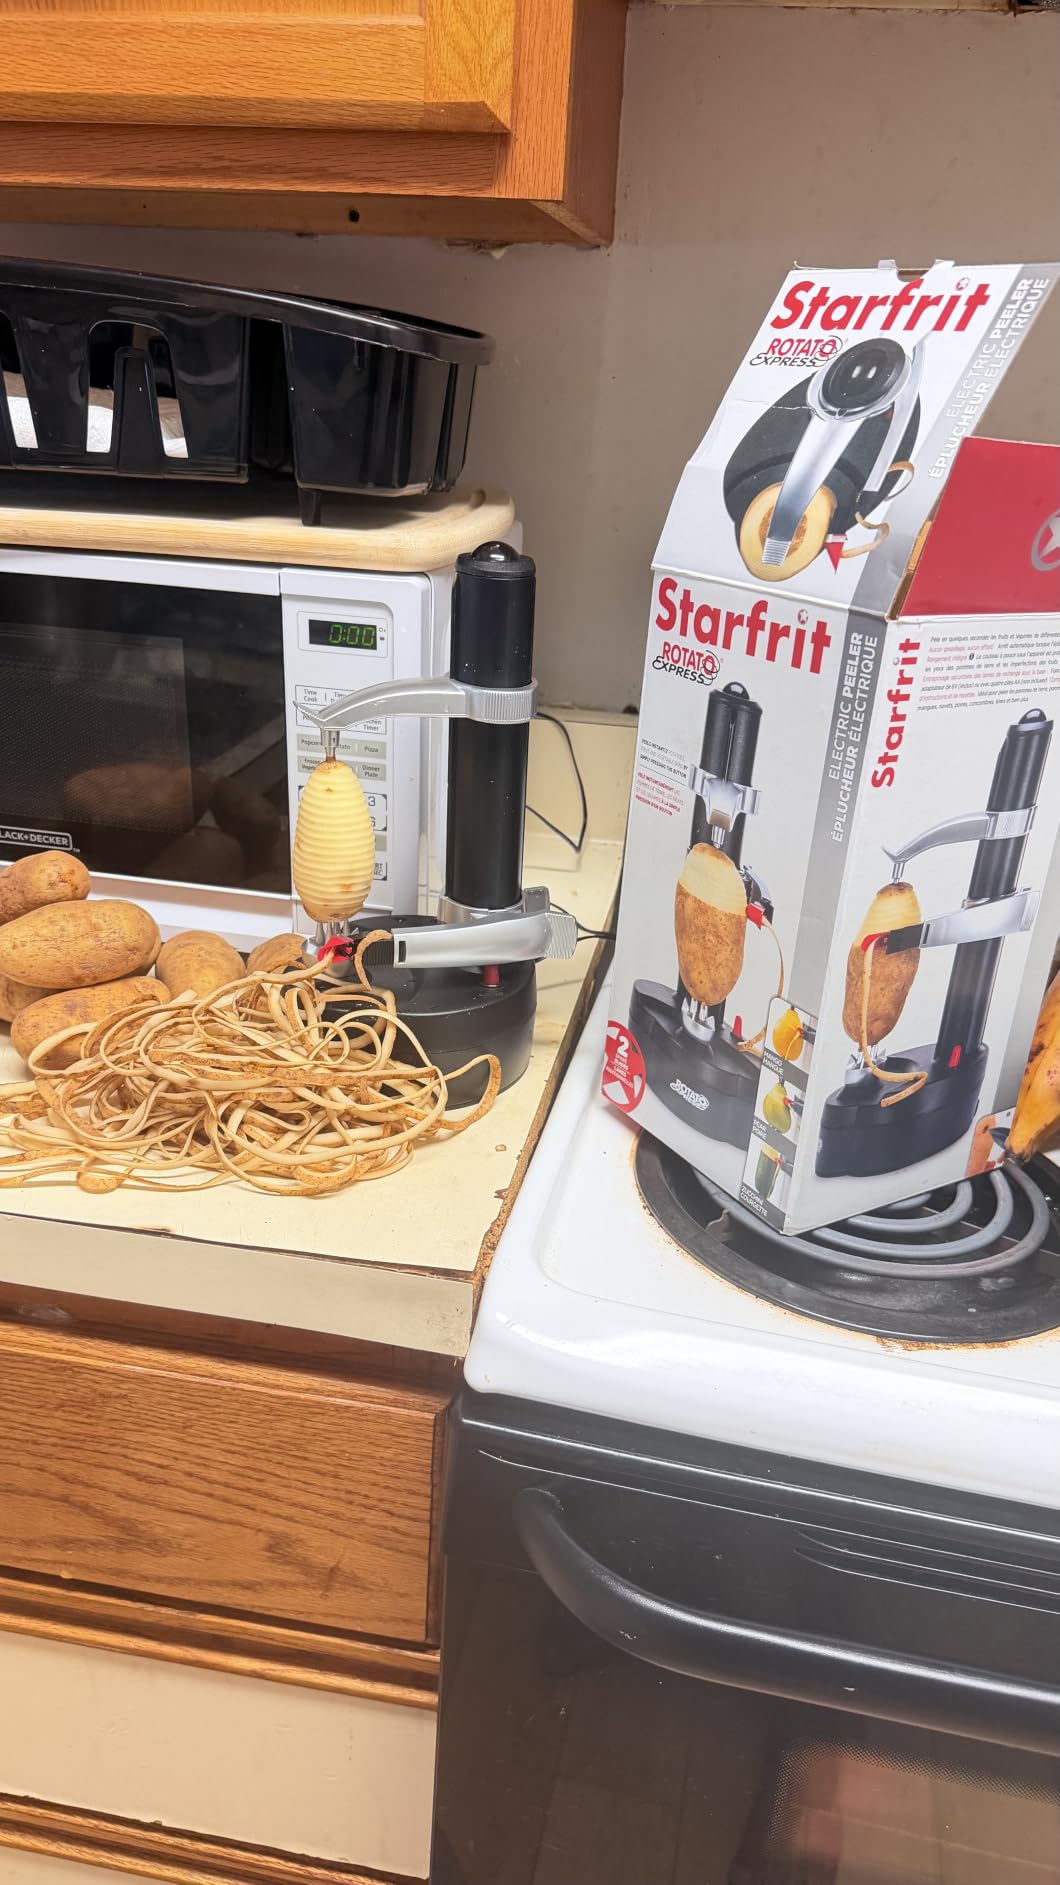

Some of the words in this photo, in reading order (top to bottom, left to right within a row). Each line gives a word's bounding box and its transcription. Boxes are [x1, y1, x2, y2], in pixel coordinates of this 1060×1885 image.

[769, 277, 990, 332] Starfrit
[749, 352, 822, 367] EXPRESS
[766, 337, 838, 358] ROTATO
[946, 343, 996, 417] ELECTRIC
[988, 278, 1034, 339] PEELER
[928, 382, 991, 479] ÉPLUCHEUR
[329, 624, 375, 647] 0:00
[655, 577, 832, 674] Starfrit
[652, 655, 706, 685] EXPRESS
[662, 641, 716, 676] ROTATO
[829, 701, 852, 780] ELECTRIC
[842, 632, 864, 699] PEELER
[871, 638, 920, 788] Starfrit
[831, 746, 859, 842] ÉPLUCHEUR
[848, 635, 878, 742] ÉLECTRIQUE
[368, 796, 376, 807] 3
[0, 831, 68, 846] LACK+DECKER
[617, 1035, 630, 1058] 2
[764, 1050, 783, 1067] MANGO
[763, 1057, 784, 1076] MANGUE
[753, 1119, 767, 1133] PEAR
[740, 1192, 768, 1217] COURGETTE
